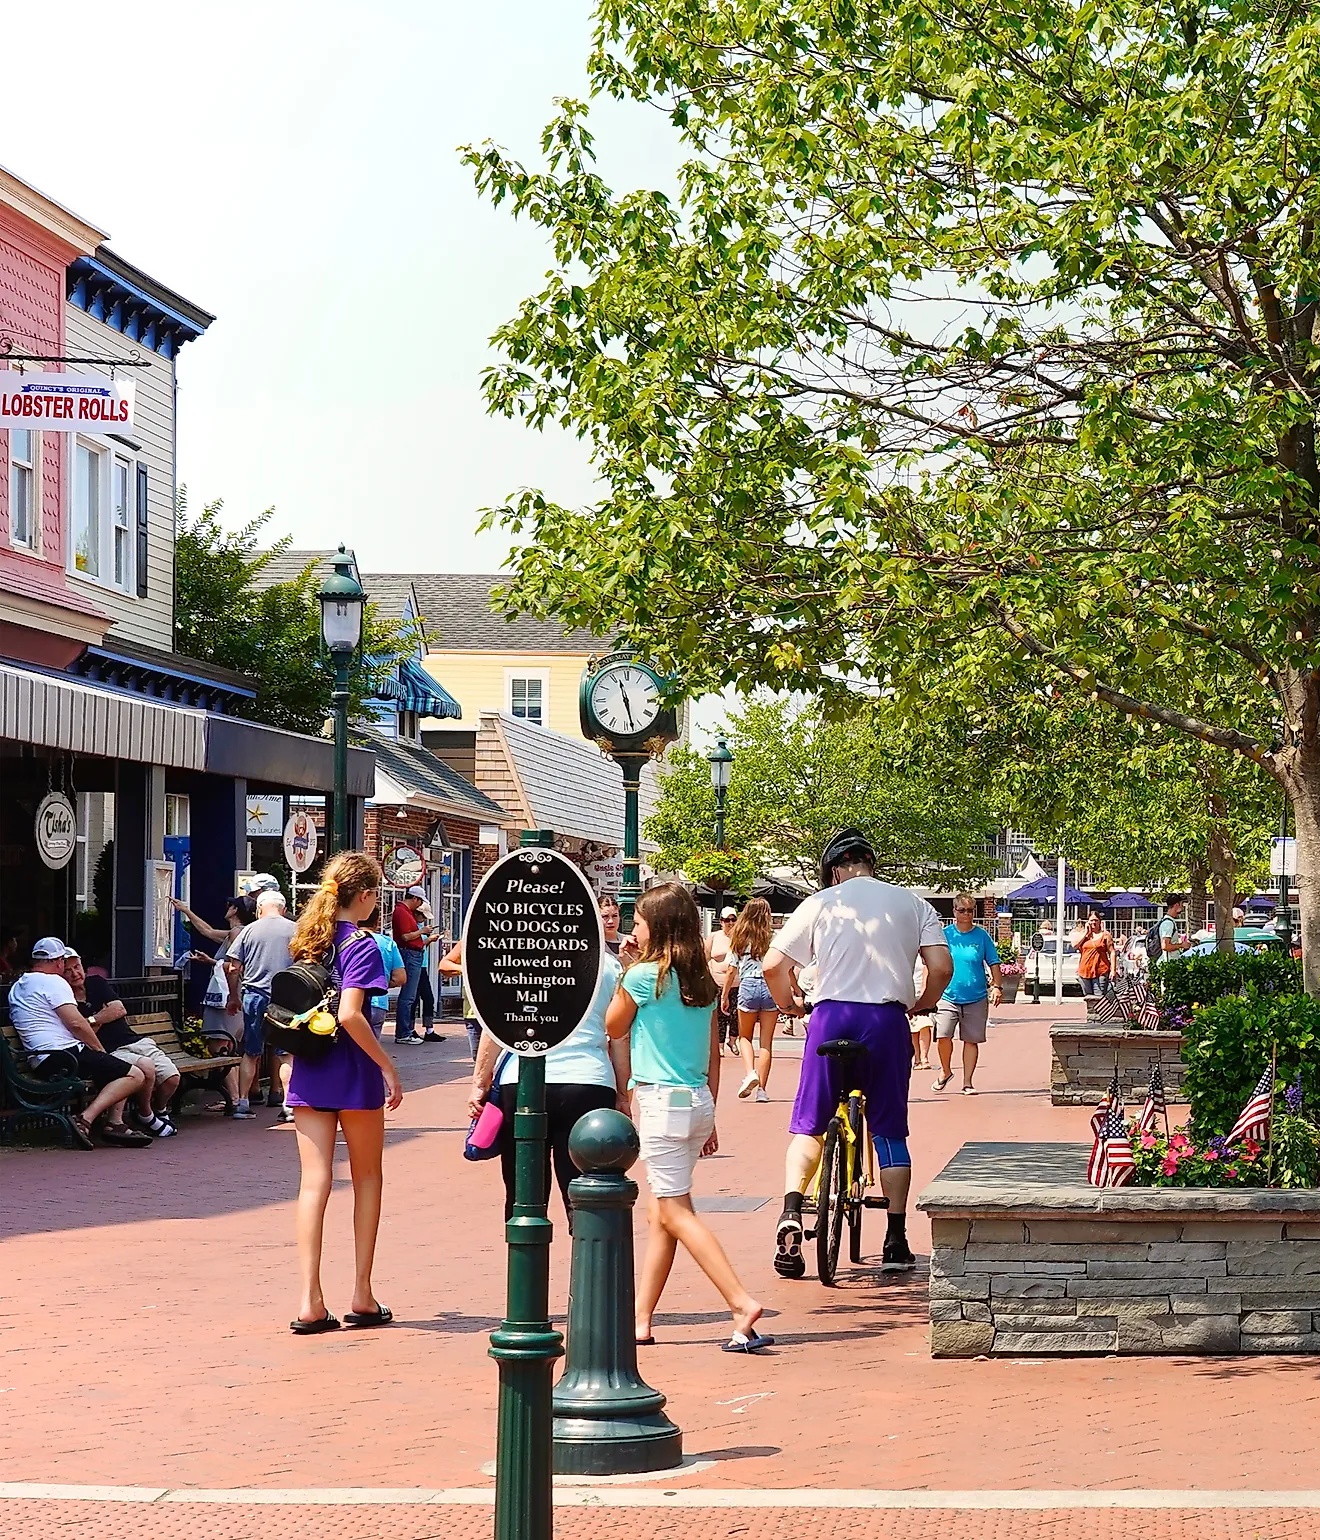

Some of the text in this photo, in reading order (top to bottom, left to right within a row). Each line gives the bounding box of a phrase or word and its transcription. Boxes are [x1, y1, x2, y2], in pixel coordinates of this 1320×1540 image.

[30, 385, 102, 394] QUINCY'S ORIGINAL
[1, 393, 129, 422] LOBSTER ROLLS
[44, 810, 71, 839] Tisha's
[594, 864, 614, 872] Uncle
[505, 879, 566, 894] Please!
[485, 902, 584, 916] NO BICYCLES
[488, 919, 579, 933] NO DOGS or
[477, 937, 589, 951] SKATEBOARDS
[493, 955, 572, 968] allowed on
[489, 972, 576, 988] Washington
[516, 990, 548, 1002] Mall
[504, 1012, 559, 1025] Thank you
